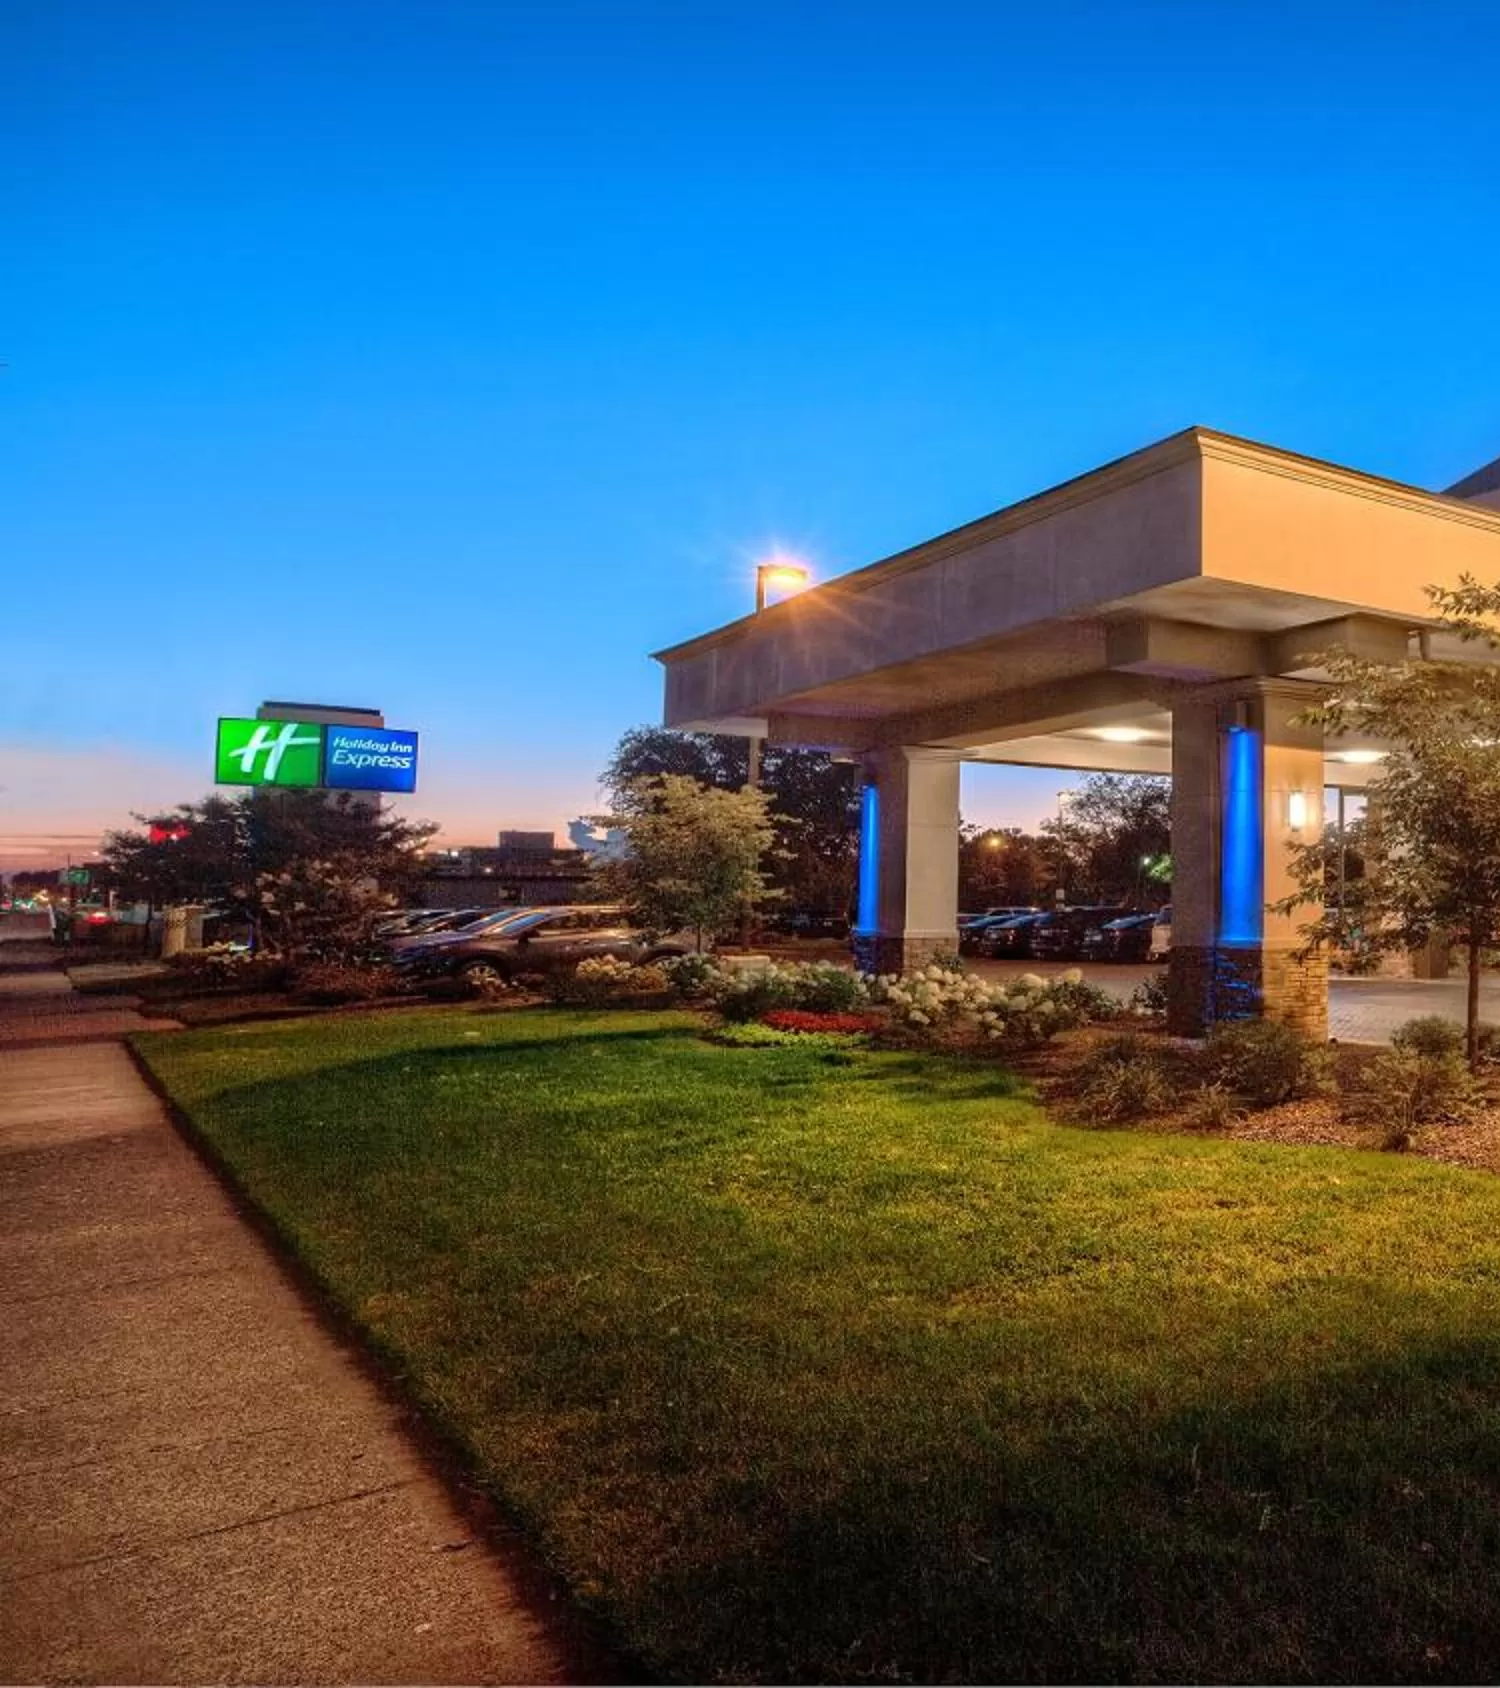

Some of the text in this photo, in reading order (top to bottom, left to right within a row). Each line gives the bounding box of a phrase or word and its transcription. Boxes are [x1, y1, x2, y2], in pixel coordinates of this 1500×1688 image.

[333, 736, 413, 753] Holiday Inn
[332, 750, 413, 769] Express
